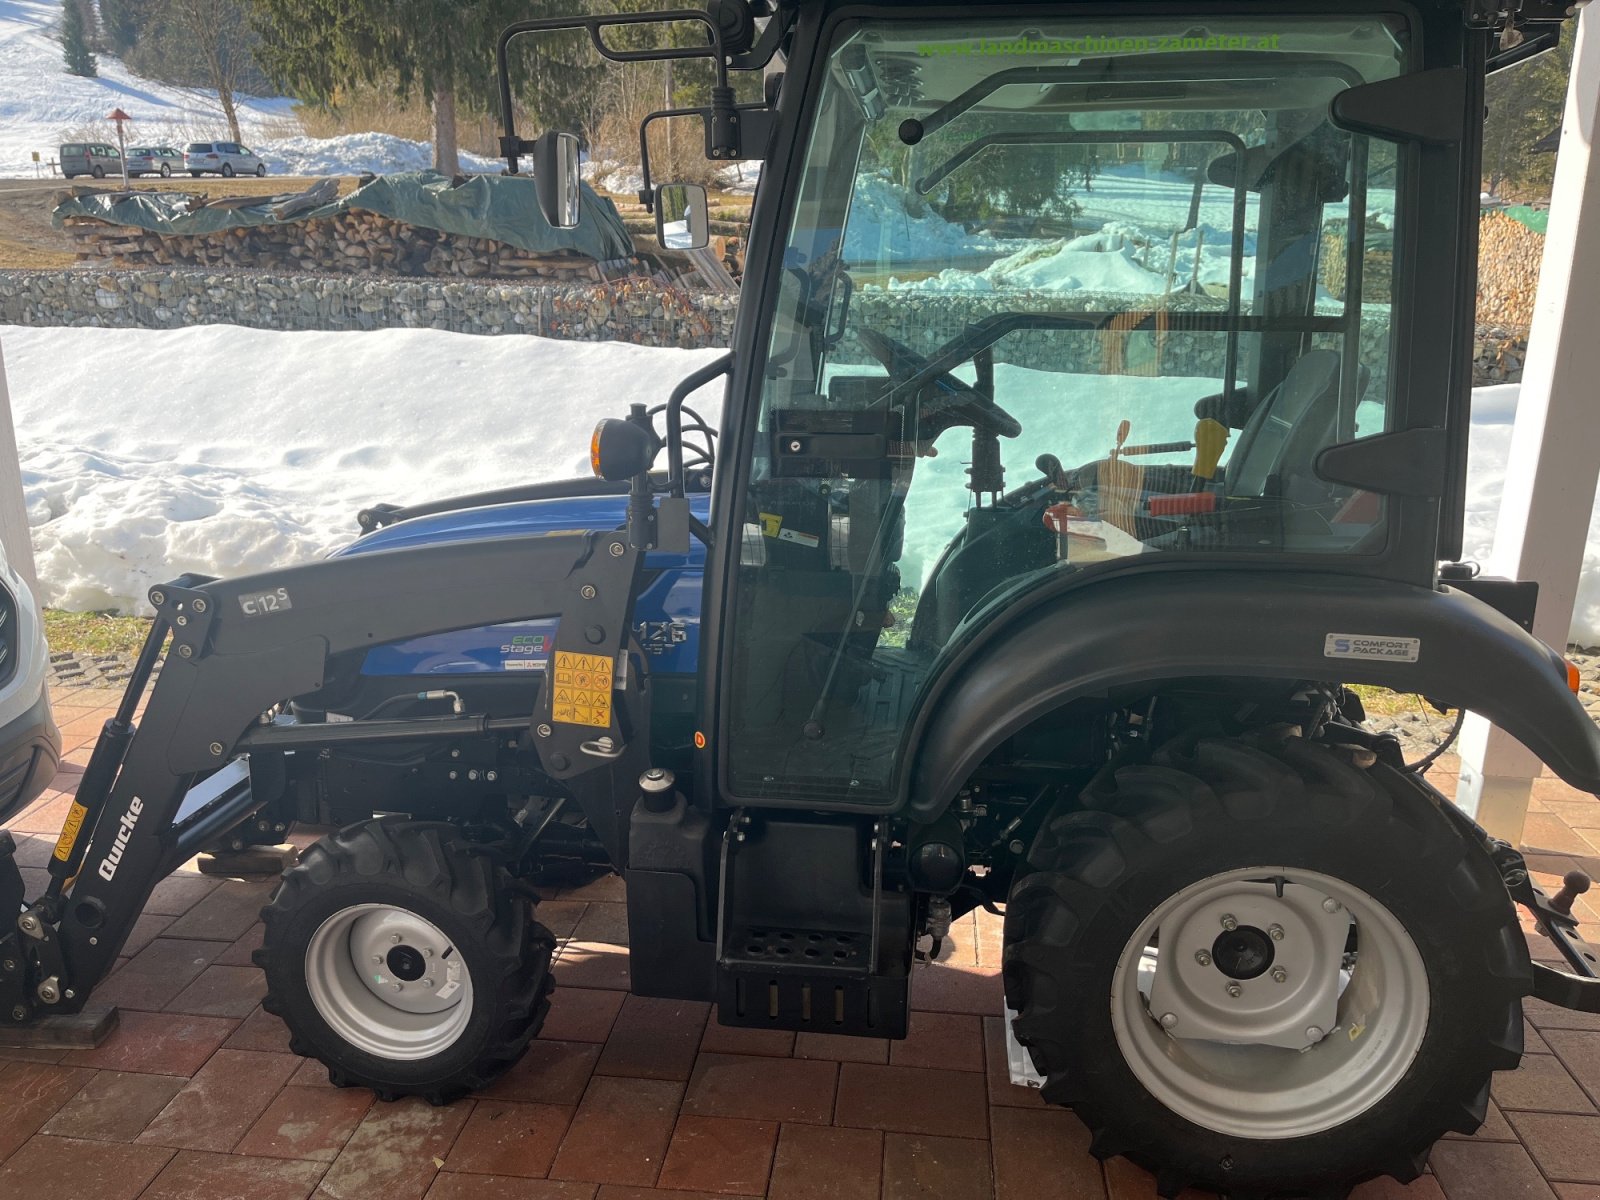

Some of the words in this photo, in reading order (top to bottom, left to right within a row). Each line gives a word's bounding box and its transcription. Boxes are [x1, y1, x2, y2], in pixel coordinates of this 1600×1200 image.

[918, 34, 1280, 56] www.landmaschinen-zameter.at
[500, 644, 543, 655] Stage
[1353, 639, 1411, 649] COMFORT
[1352, 646, 1409, 657] PACKAGE
[98, 795, 144, 882] Quicke
